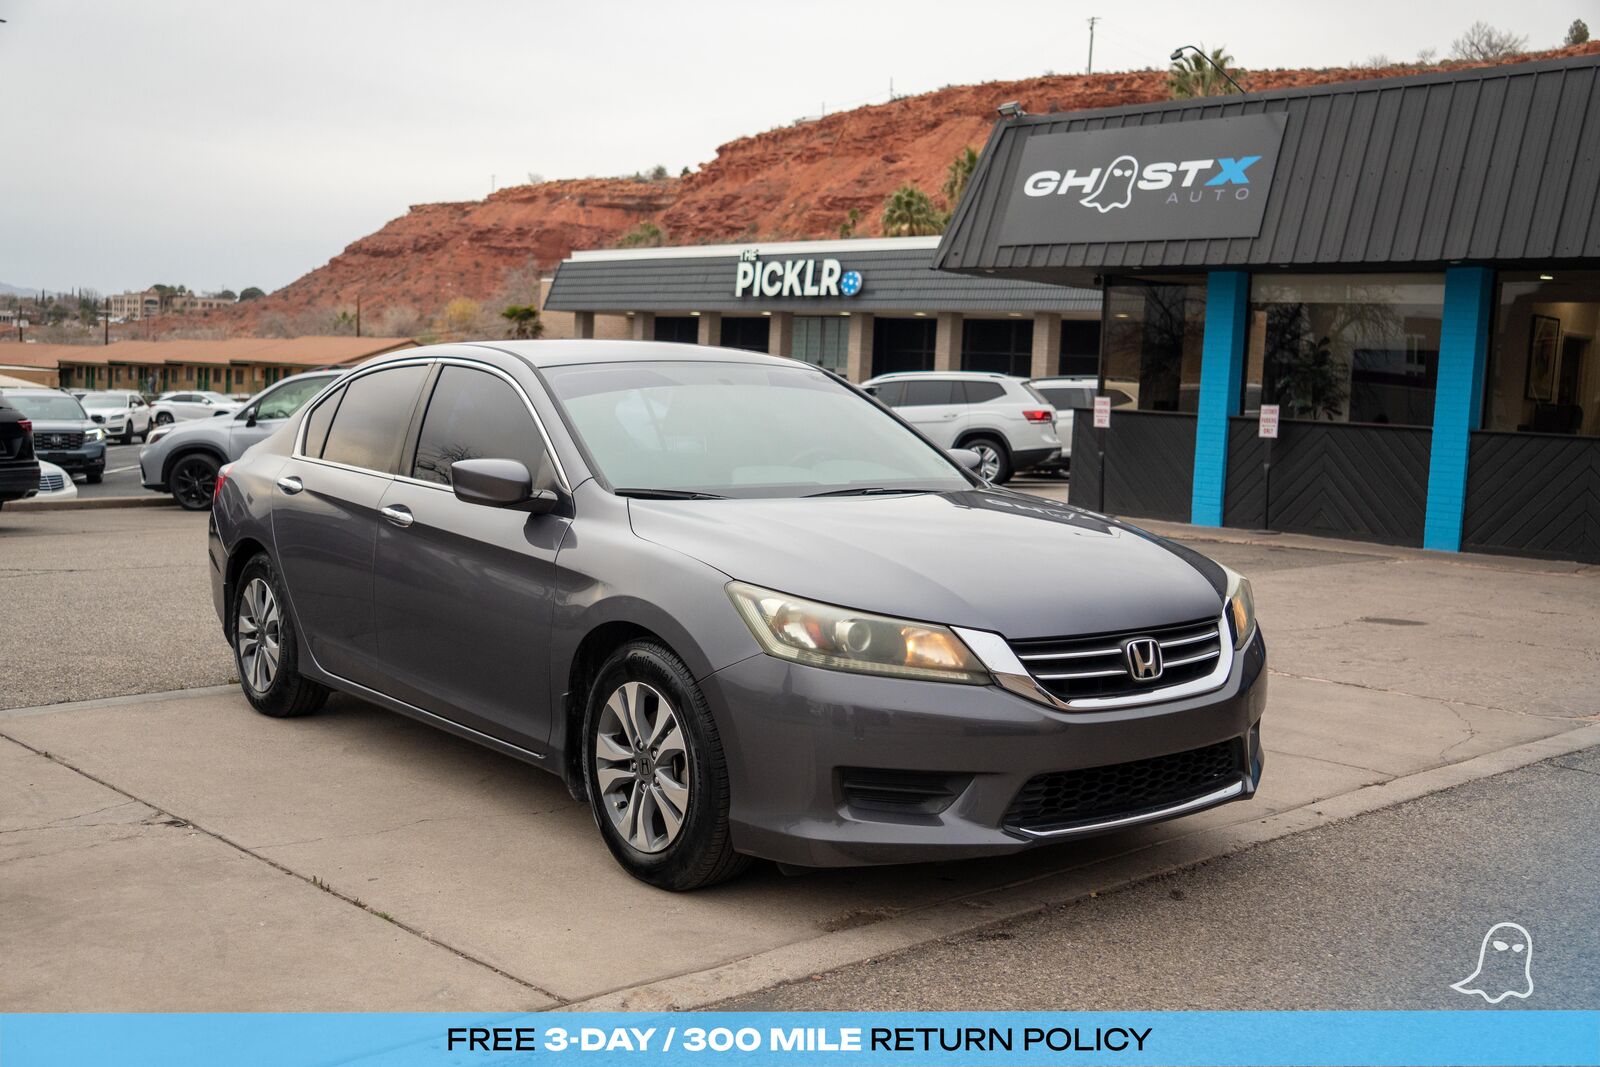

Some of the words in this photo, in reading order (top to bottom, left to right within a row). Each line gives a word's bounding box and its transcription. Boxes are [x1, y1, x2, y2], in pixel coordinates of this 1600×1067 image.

[1166, 188, 1250, 204] AUTO
[740, 249, 759, 261] THE
[735, 259, 841, 297] PICKLR
[629, 653, 673, 681] Continental
